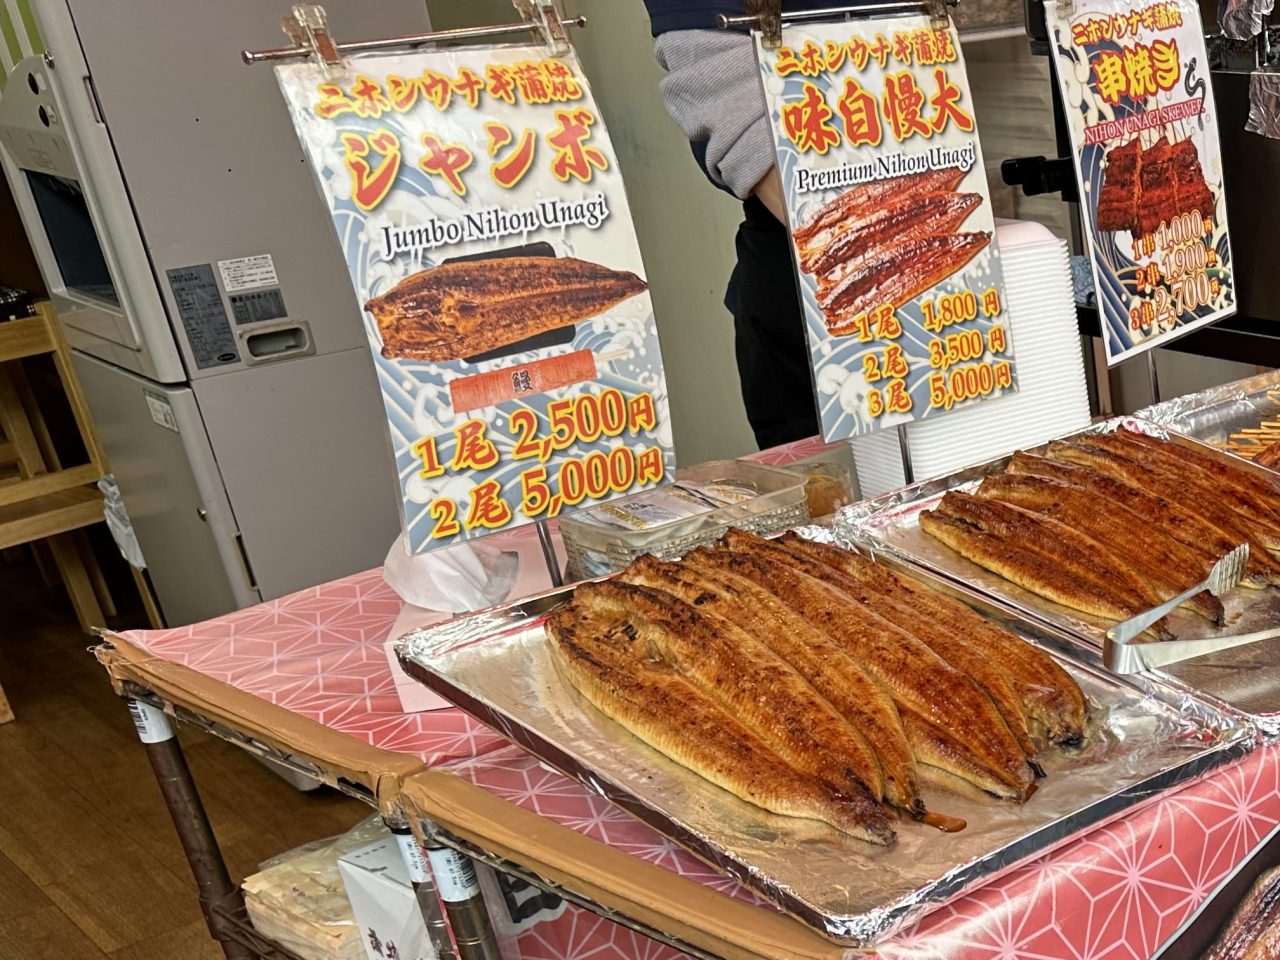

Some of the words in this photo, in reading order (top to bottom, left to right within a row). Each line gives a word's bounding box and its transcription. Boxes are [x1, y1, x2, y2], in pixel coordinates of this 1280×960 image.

[777, 30, 955, 75] ニホンウナギ蒲焼
[1094, 38, 1180, 104] 串焼き
[317, 60, 582, 118] ニホンウナギ蒲焼
[1085, 121, 1125, 143] NIHON
[1126, 109, 1160, 132] UNAGI
[342, 109, 607, 211] ジャンボ
[797, 162, 873, 190] Premium
[878, 153, 927, 176] Nihon
[929, 143, 974, 168] Unagi
[382, 218, 460, 255] Jumbo
[466, 209, 536, 238] Nihon
[540, 194, 606, 228] Unagi
[856, 304, 901, 341] 1尾
[864, 344, 908, 381] 2尾
[868, 379, 912, 416] 3尾
[416, 420, 498, 478] 1尾
[511, 390, 655, 461] 2,500円
[431, 481, 511, 538] 2尾
[521, 447, 663, 517] 5,000円
